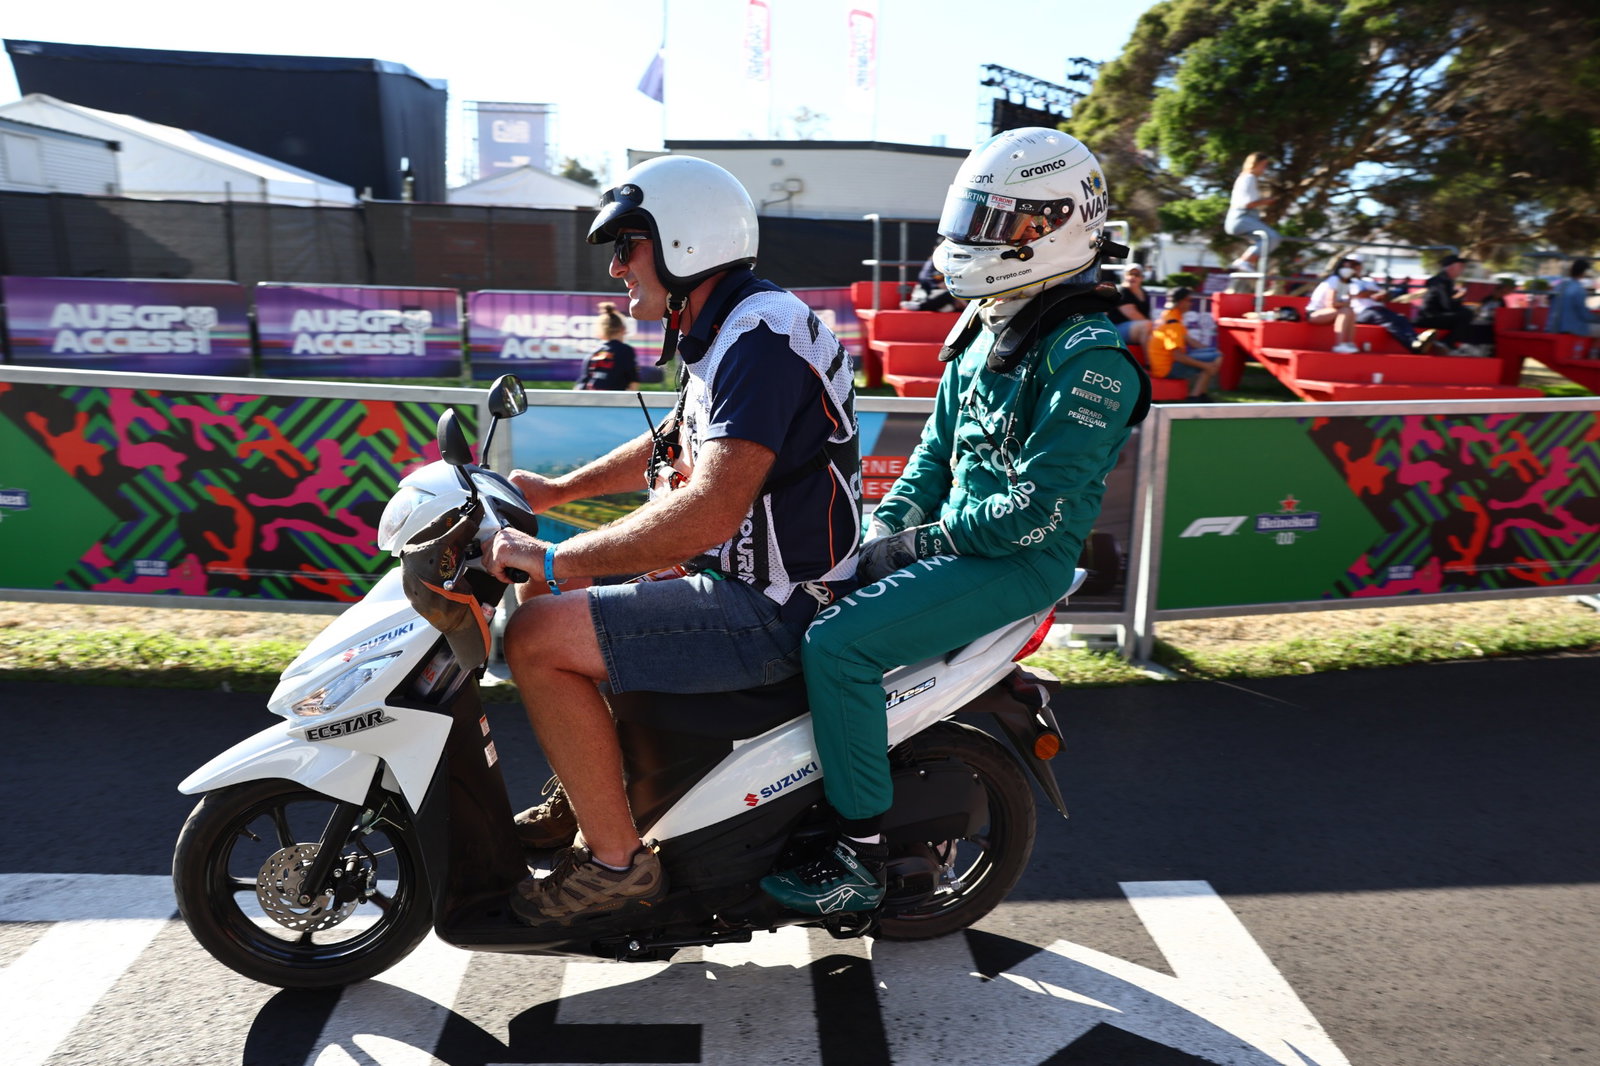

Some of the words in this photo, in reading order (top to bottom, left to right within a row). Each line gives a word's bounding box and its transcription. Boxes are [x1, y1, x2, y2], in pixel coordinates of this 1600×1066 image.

[1020, 159, 1066, 178] aramco
[1079, 191, 1108, 223] WAR
[995, 268, 1032, 281] crypto.com
[50, 302, 184, 329] AUSGP
[290, 309, 403, 332] AUSGP
[51, 329, 195, 354] ACCESS
[291, 333, 414, 355] ACCESS
[1082, 369, 1122, 393] EPOS
[1067, 410, 1108, 429] PERREGAUX
[1078, 406, 1103, 420] GIRARD
[358, 622, 415, 653] SUZUKI
[305, 708, 393, 742] ECSTAR
[760, 761, 819, 798] SUZUKI
